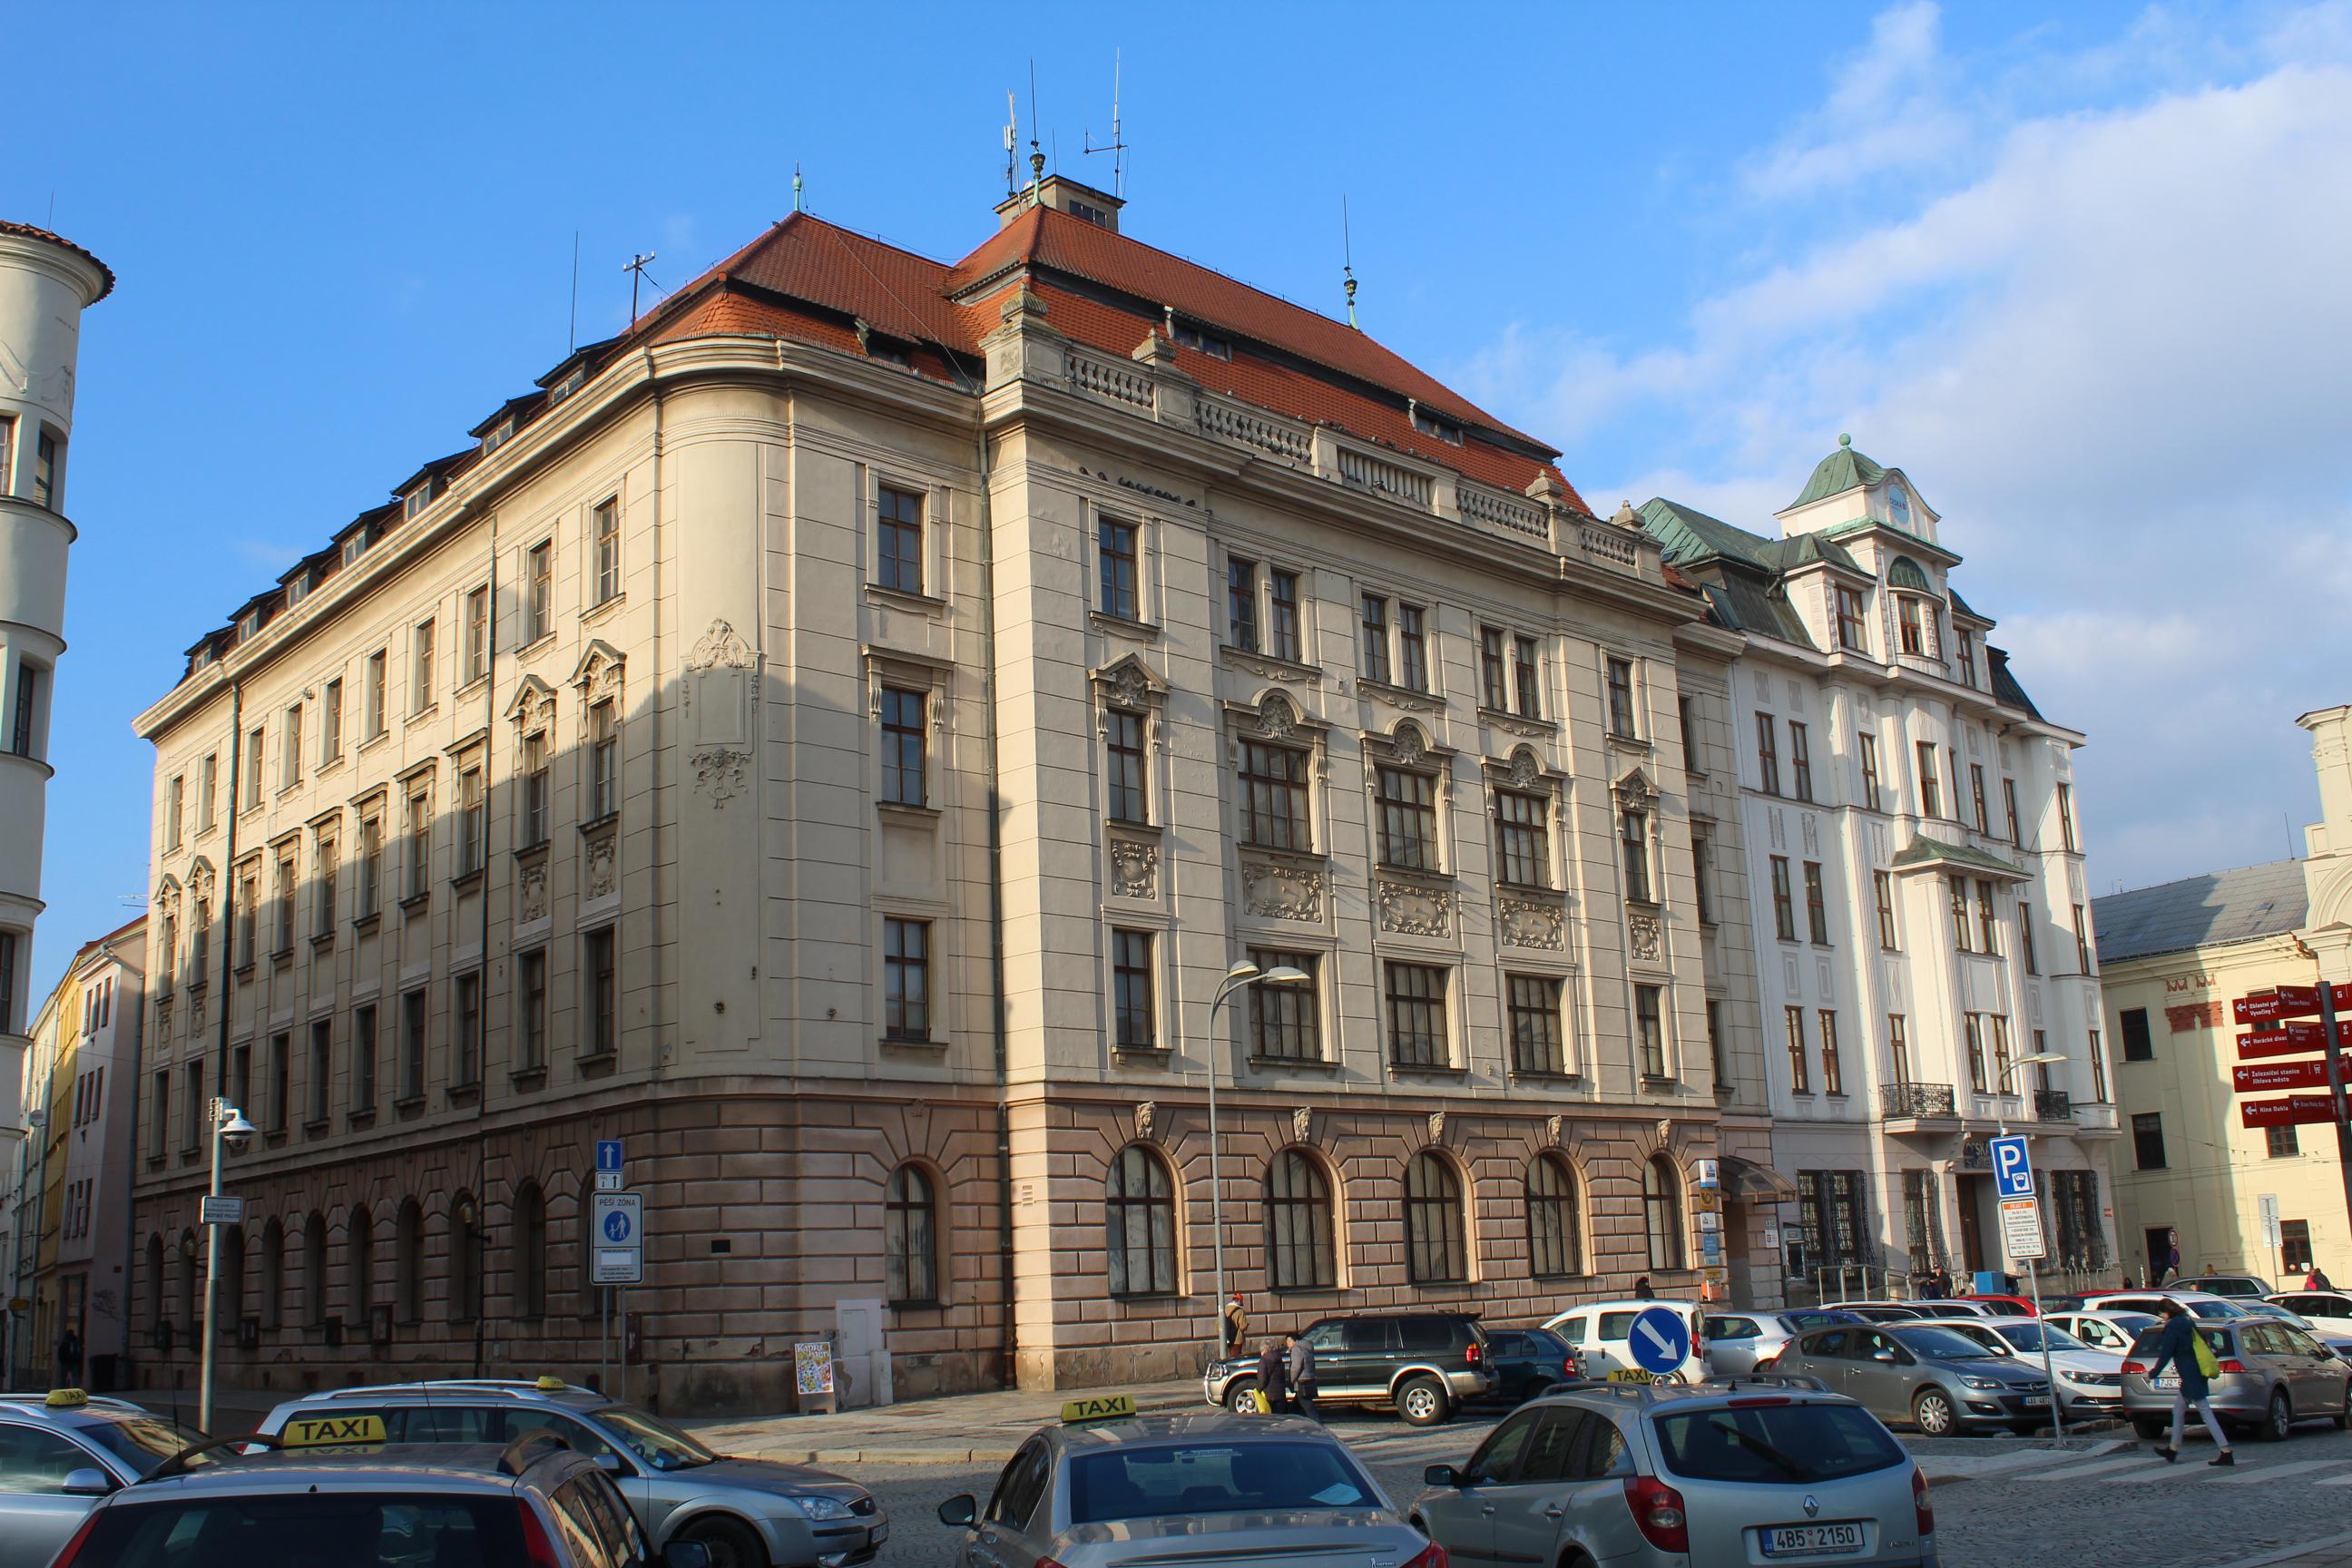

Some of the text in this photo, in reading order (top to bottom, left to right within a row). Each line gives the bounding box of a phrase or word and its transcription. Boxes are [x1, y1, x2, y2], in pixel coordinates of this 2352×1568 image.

[617, 1197, 636, 1206] ZÓNA
[1613, 1369, 1649, 1382] TAXI
[1073, 1396, 1127, 1416] TAXI
[298, 1418, 369, 1440] TAXI
[1776, 1530, 1806, 1549] 4B5
[1817, 1526, 1856, 1546] 2150
